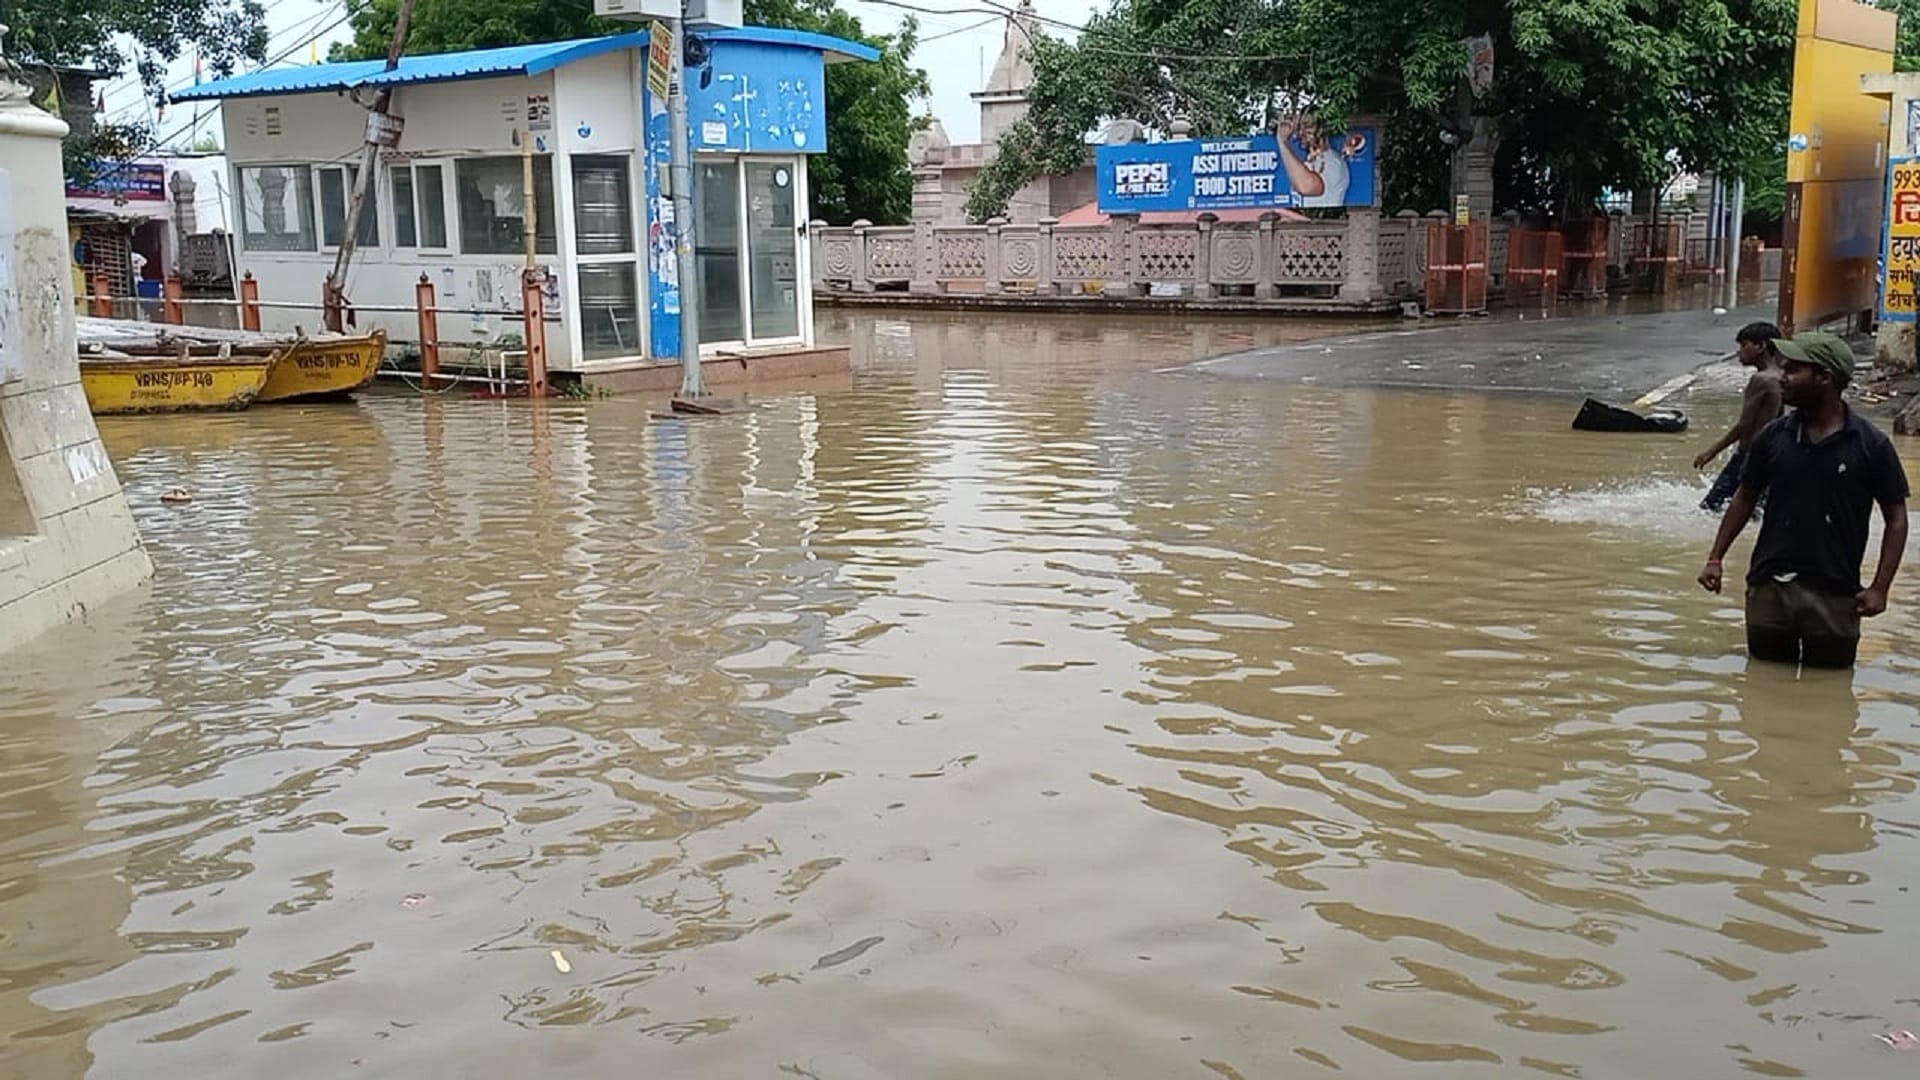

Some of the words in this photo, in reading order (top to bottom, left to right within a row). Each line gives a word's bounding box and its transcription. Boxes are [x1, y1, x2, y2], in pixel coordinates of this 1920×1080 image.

[1201, 141, 1252, 152] WELCOME
[1192, 155, 1219, 174] ASSI
[1222, 152, 1278, 172] HYGIENIC
[1116, 163, 1168, 184] PEPSI
[1195, 177, 1226, 195] FOOD
[1228, 175, 1275, 194] STREET
[134, 372, 213, 389] VRNS/BP-148
